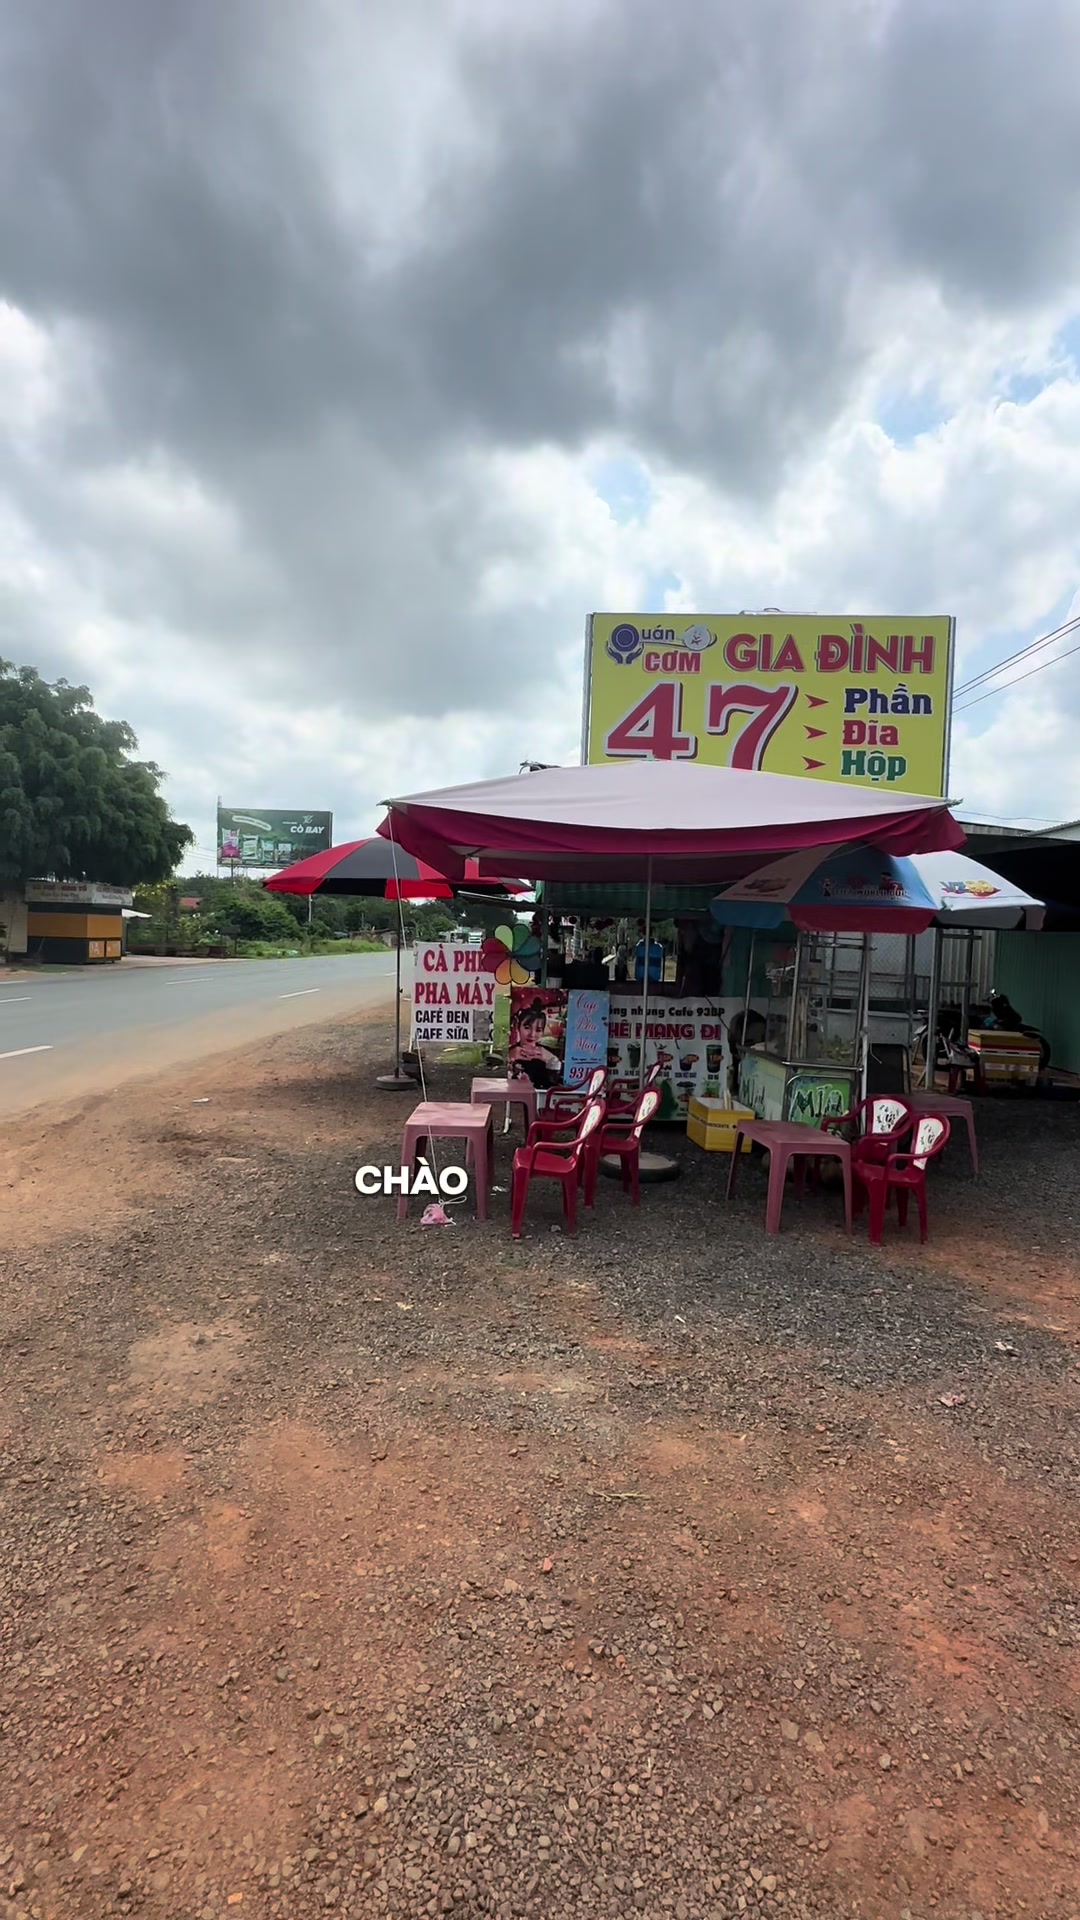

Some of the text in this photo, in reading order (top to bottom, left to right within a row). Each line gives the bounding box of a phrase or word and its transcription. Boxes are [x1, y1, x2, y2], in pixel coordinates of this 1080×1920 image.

[724, 623, 935, 673] GIA ĐÌNH
[644, 650, 701, 674] CƠM
[843, 682, 933, 715] Phần
[605, 682, 798, 772] 47
[842, 719, 899, 746] Đĩa
[841, 750, 907, 781] Hộp
[423, 944, 448, 972] CÀ
[414, 976, 495, 1005] PHA MÁY
[446, 1010, 470, 1024] ĐEN
[697, 1008, 725, 1017] 93BP
[446, 1026, 469, 1040] SỮA
[700, 1024, 721, 1040] ĐI
